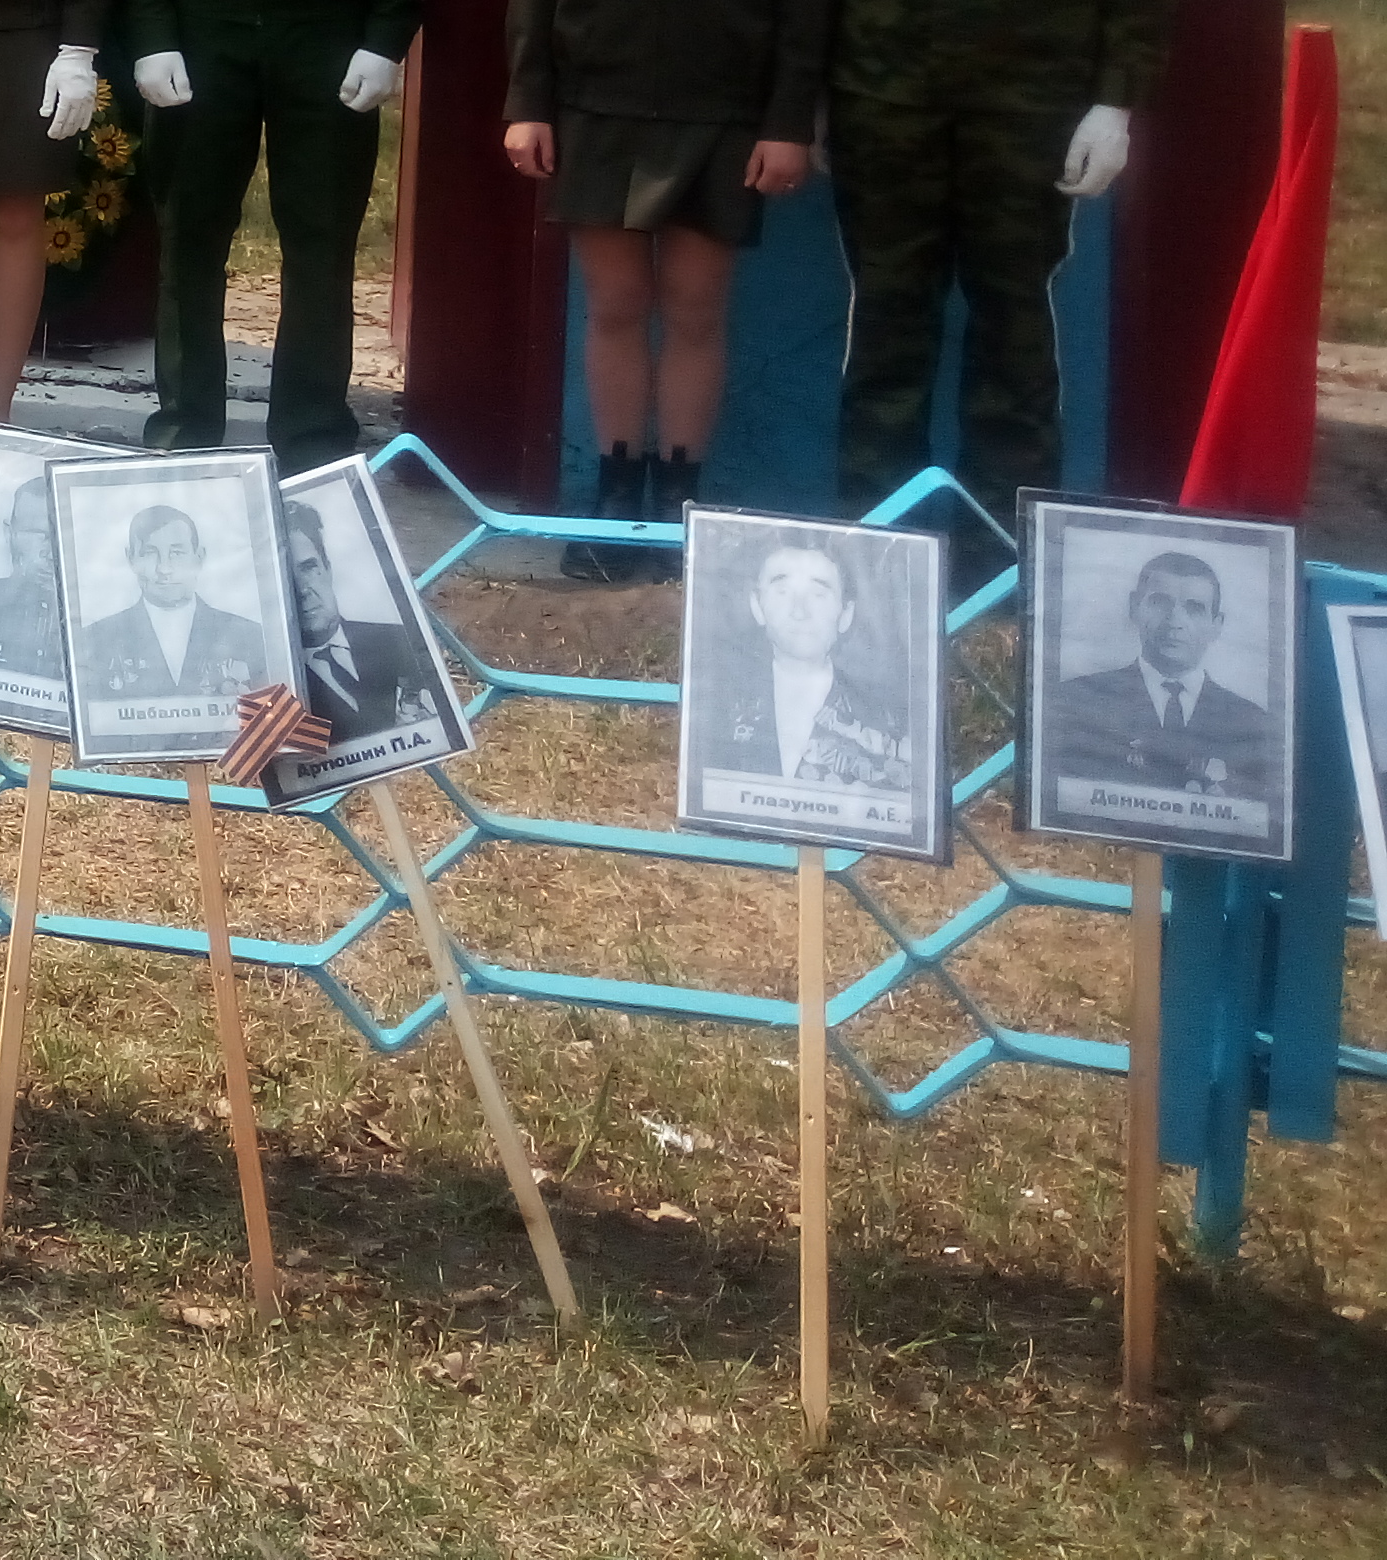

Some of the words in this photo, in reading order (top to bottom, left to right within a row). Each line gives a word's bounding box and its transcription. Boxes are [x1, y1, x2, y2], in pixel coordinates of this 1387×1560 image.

[117, 705, 202, 721] Шабалов
[297, 744, 387, 778] Артюшин
[389, 731, 432, 753] П.А.
[739, 790, 840, 815] Глазунов
[1089, 788, 1184, 814] Денисов
[1189, 801, 1241, 822] М.М.
